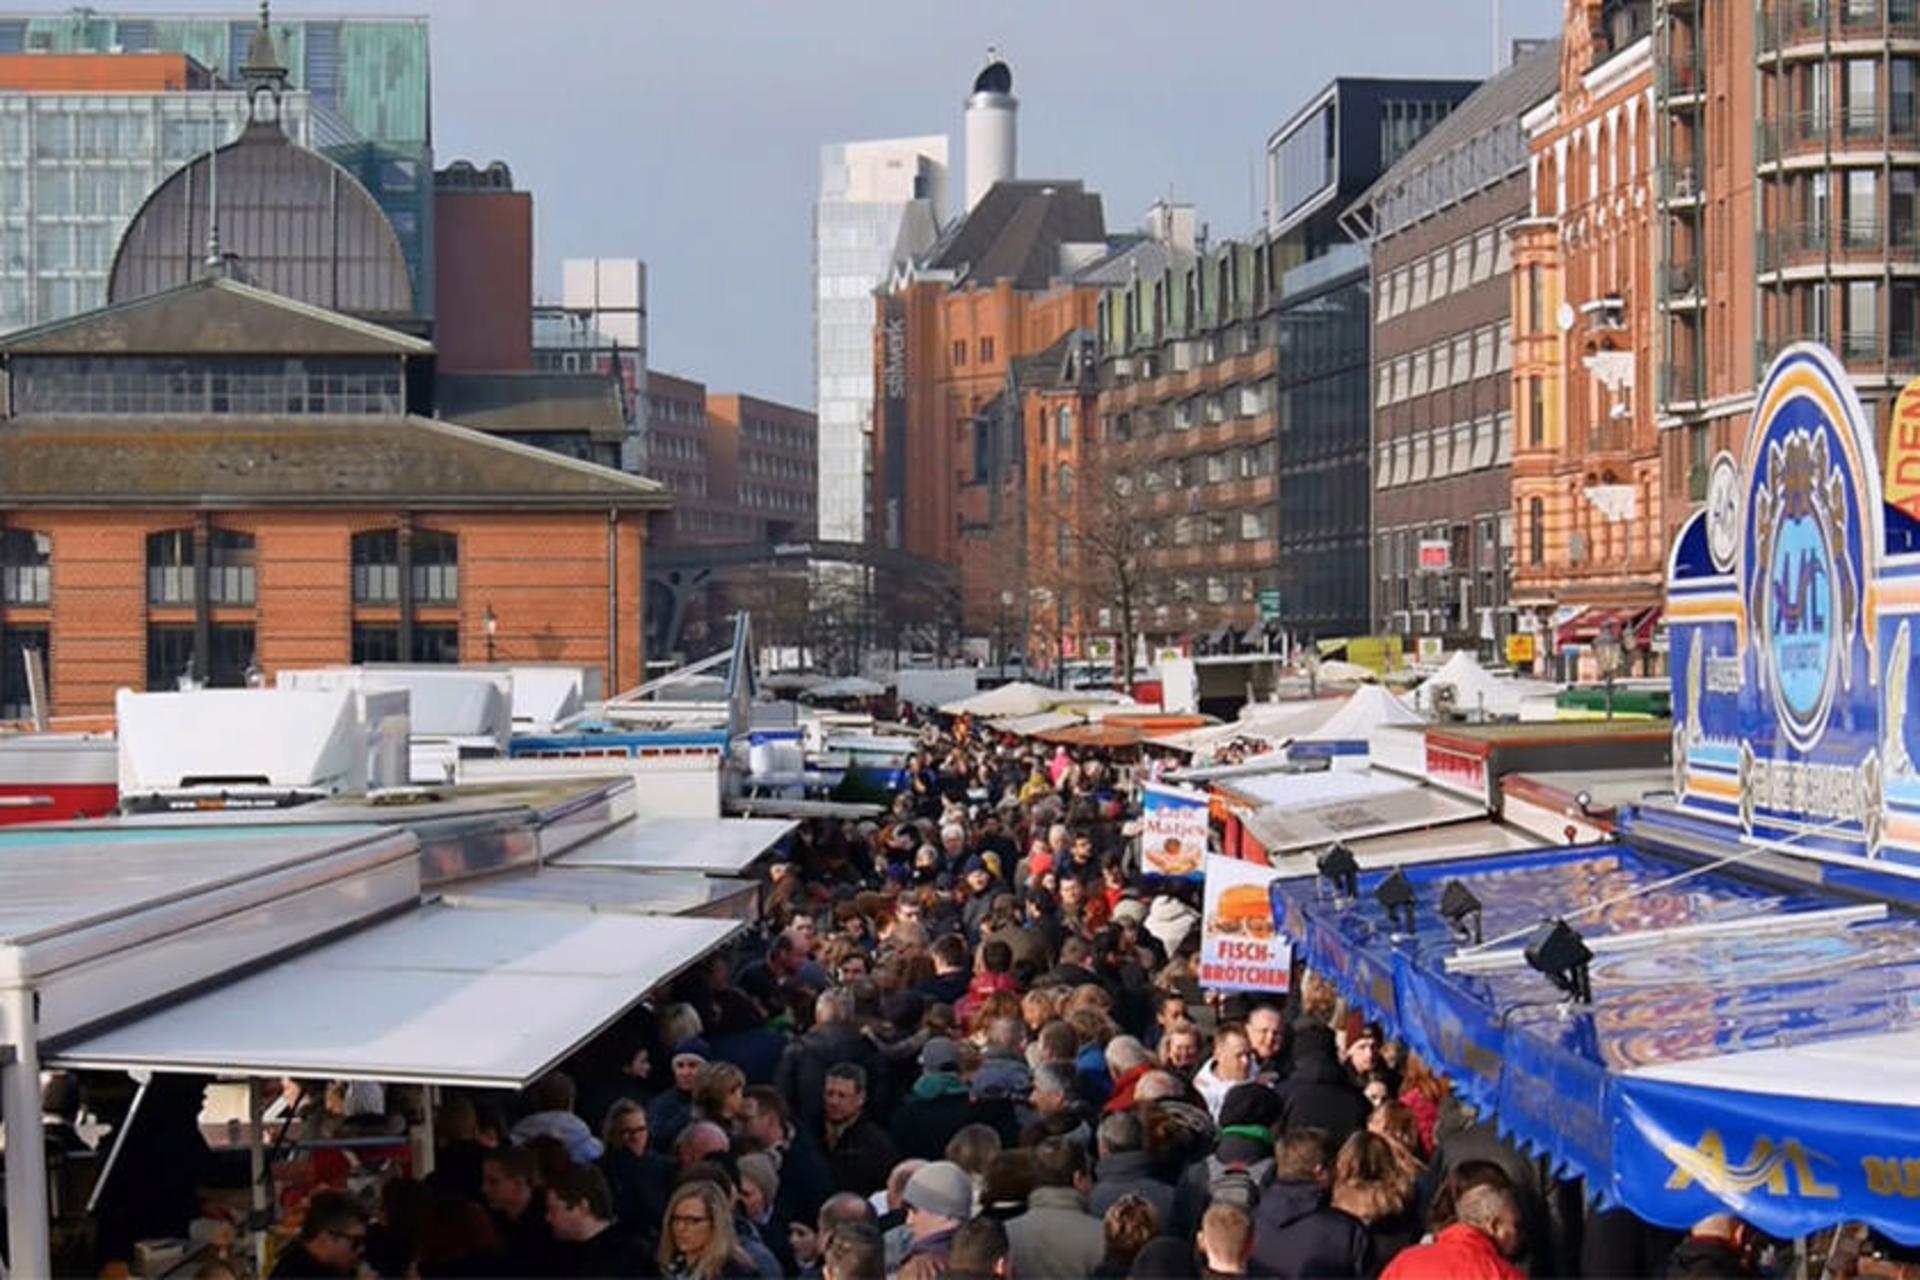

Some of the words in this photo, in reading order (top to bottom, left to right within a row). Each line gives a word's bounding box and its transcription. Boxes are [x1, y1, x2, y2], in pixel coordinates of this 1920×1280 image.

[1147, 820, 1205, 837] Matjes
[1218, 941, 1275, 961] FISCH-
[1201, 963, 1287, 985] BRÖTCHEN
